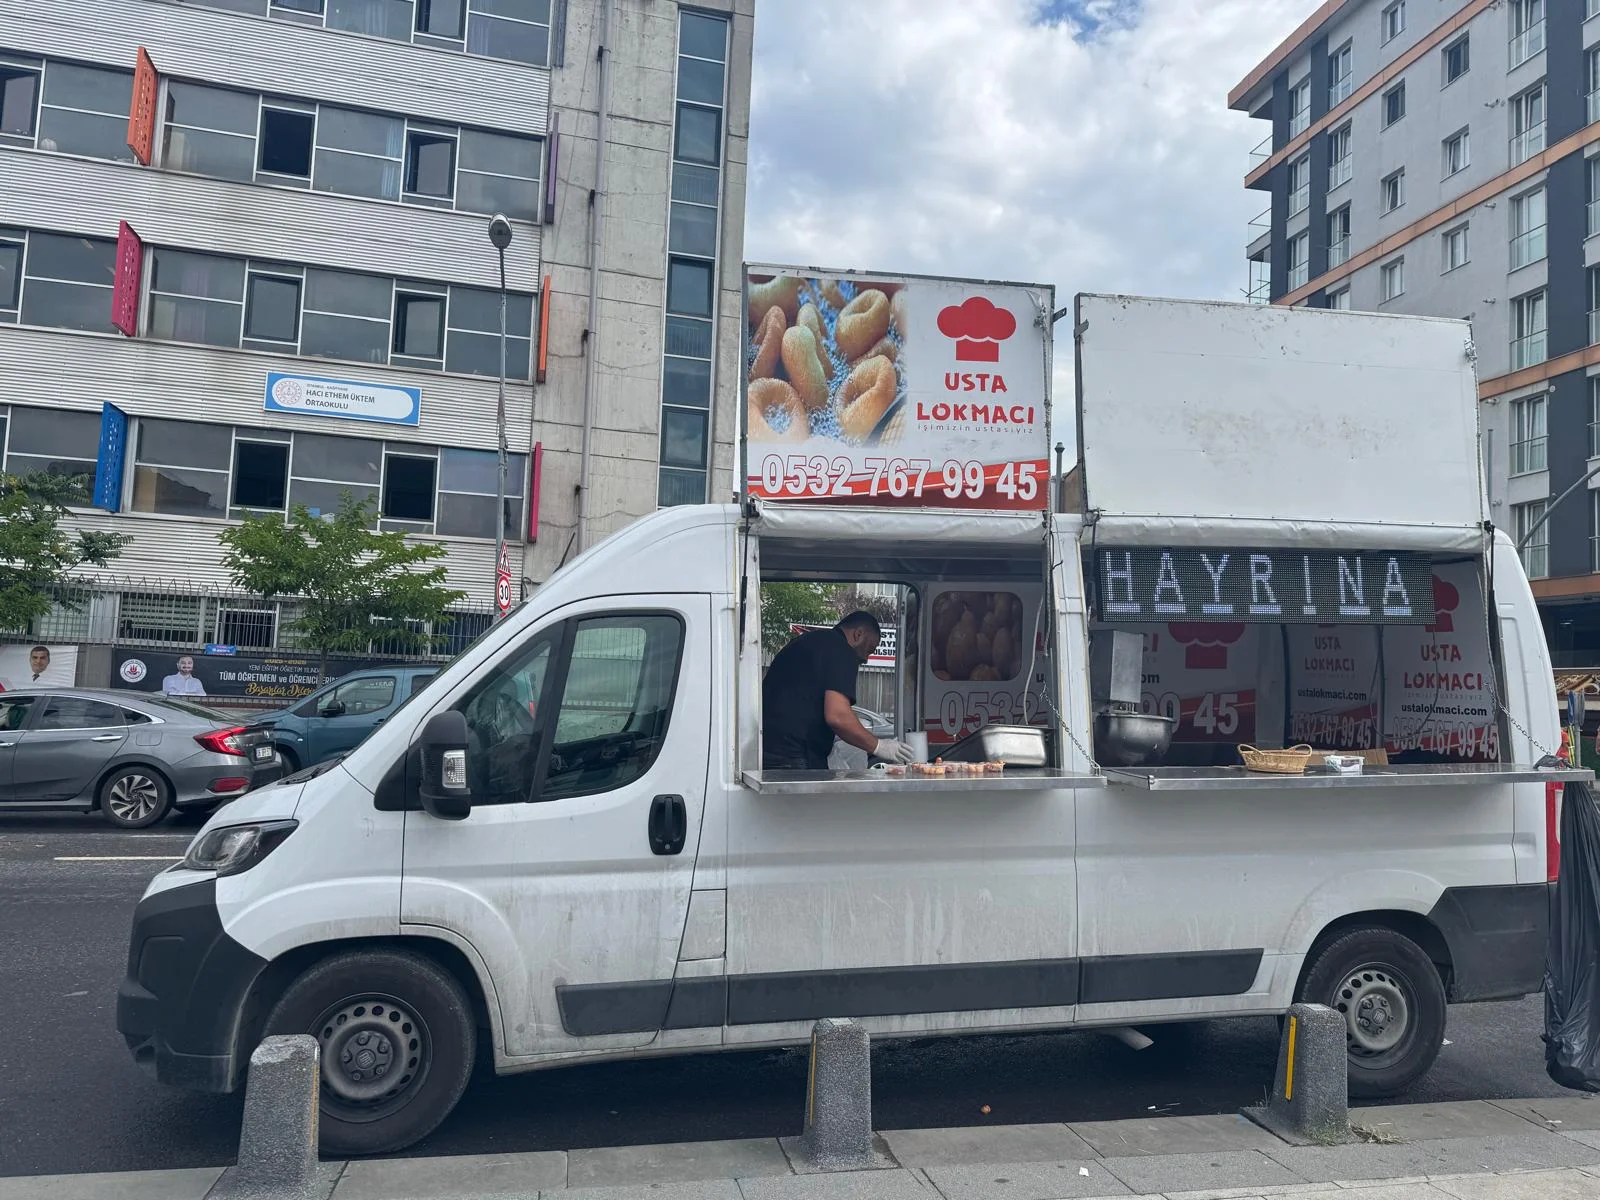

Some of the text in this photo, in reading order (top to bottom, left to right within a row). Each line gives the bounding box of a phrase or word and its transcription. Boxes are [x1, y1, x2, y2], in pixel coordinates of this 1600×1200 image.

[945, 372, 1008, 394] USTA
[305, 398, 349, 409] ORTAOKULU
[306, 389, 375, 403] HACI ETHEM ÜKTEM
[917, 402, 1034, 425] LOKMACI
[918, 424, 970, 432] işimizin
[762, 454, 1038, 501] 0532 767 99 45
[1106, 552, 1411, 615] HAYRINA
[500, 585, 508, 600] 30
[1315, 637, 1341, 650] USTA
[1420, 644, 1462, 662] USTA
[1304, 658, 1355, 672] LOKMACI
[219, 671, 235, 680] TÜM
[237, 672, 277, 683] ÖĞRETMEN
[1403, 672, 1483, 691] LOKMACI
[1297, 687, 1367, 700] ustalokmaci.com
[1193, 692, 1239, 735] 45
[1401, 703, 1488, 716] ustalokmaci.com
[1340, 716, 1355, 748] 99
[1356, 718, 1372, 749] 45
[1426, 719, 1454, 756] 767
[1457, 721, 1476, 758] 99
[1479, 722, 1499, 760] 45
